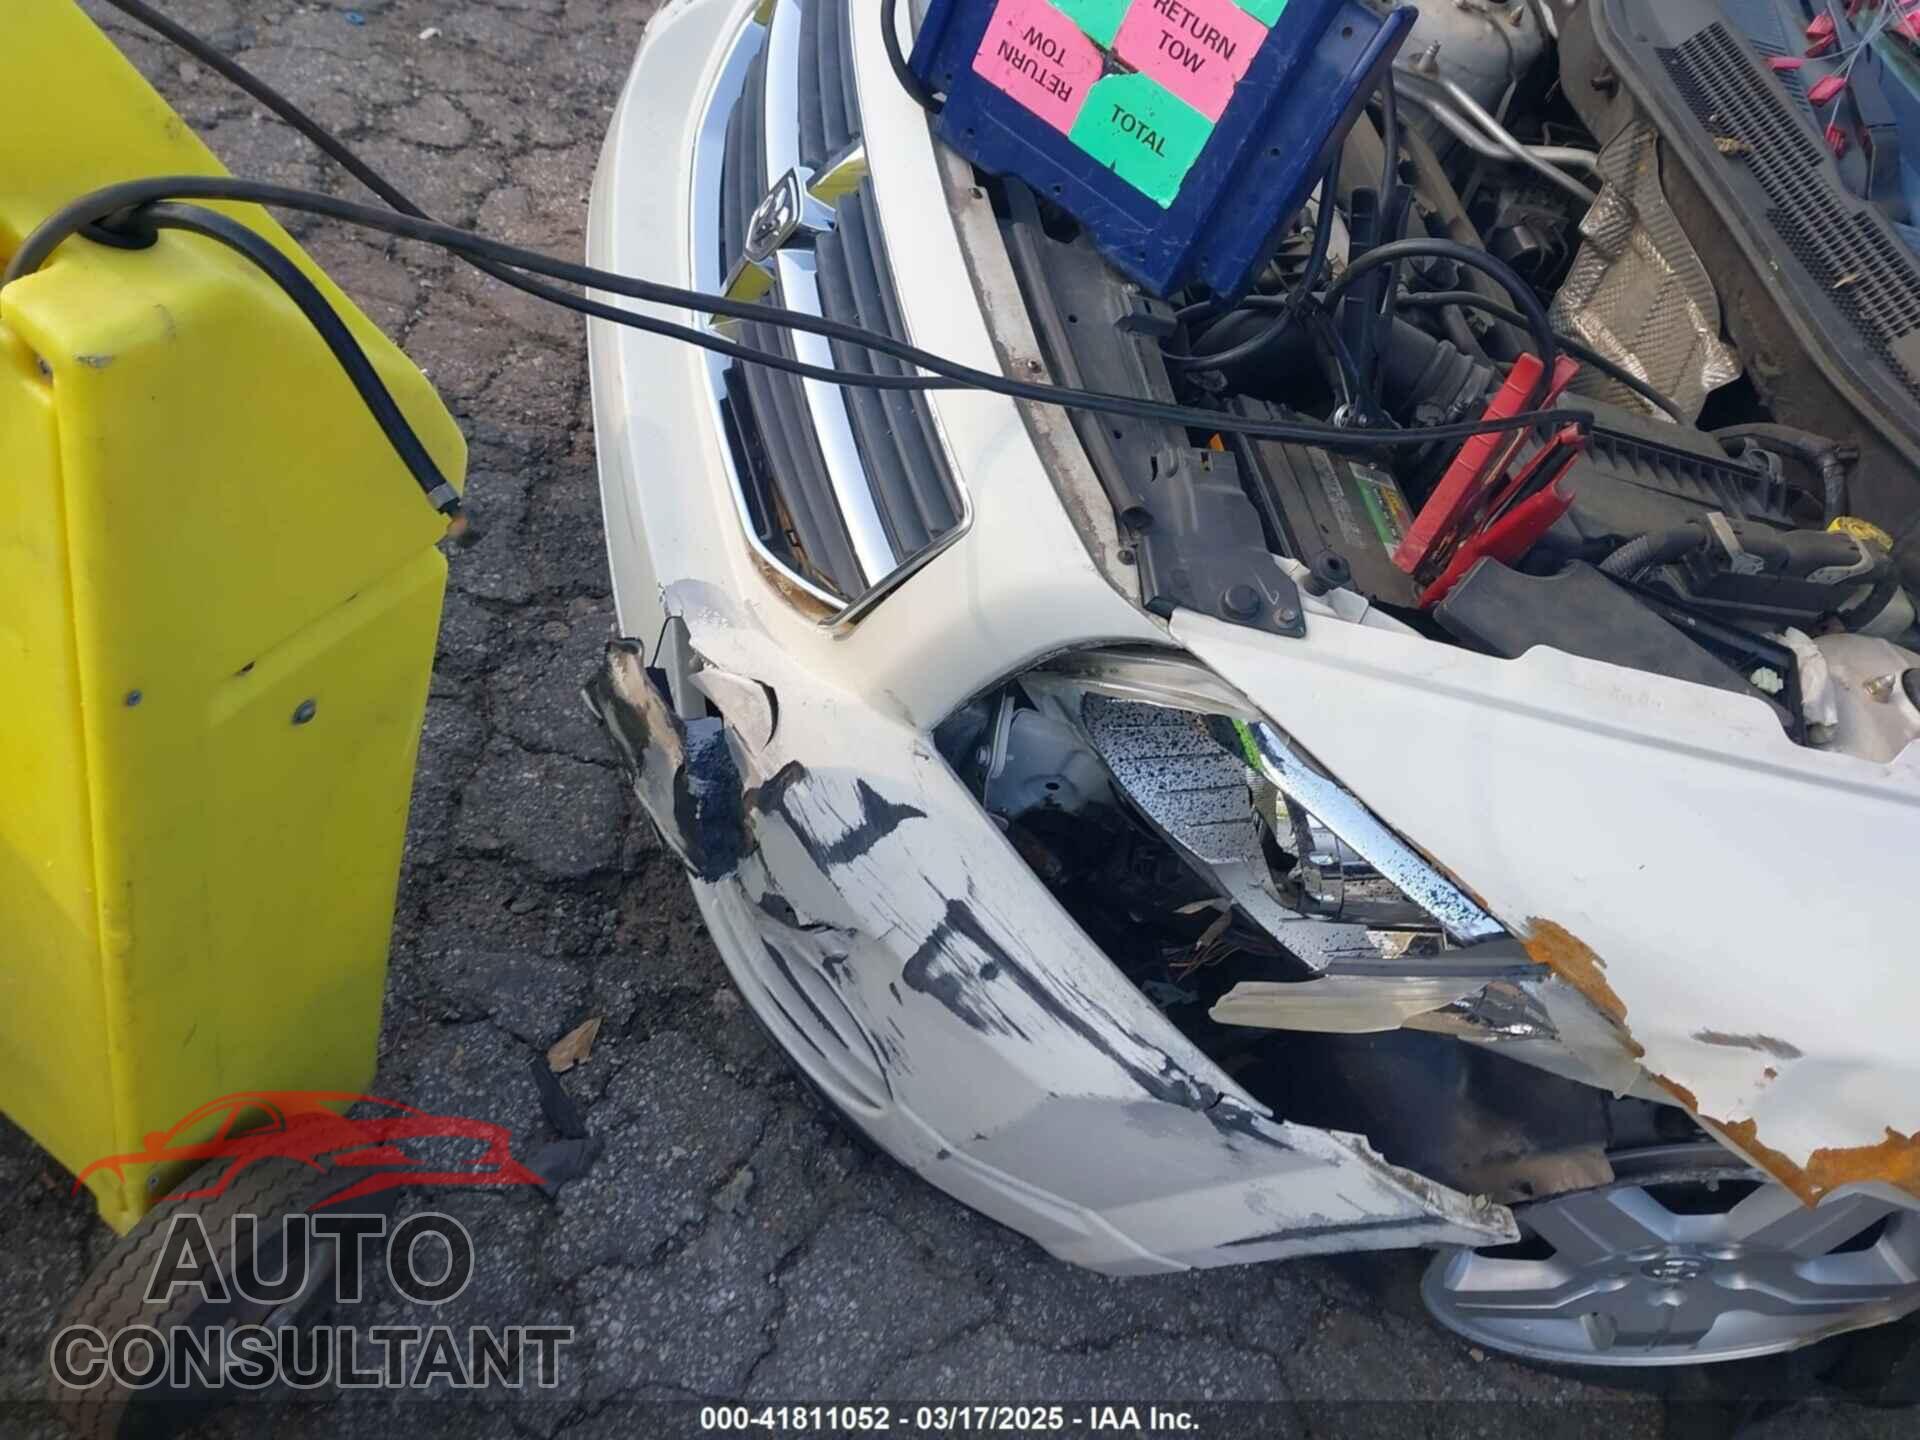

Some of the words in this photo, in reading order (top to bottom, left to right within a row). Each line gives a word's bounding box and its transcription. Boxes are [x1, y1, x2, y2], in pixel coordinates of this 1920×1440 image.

[1023, 26, 1067, 67] TOW
[1152, 0, 1237, 61] RETURN
[1158, 32, 1206, 75] TOW
[997, 39, 1073, 102] RETURN
[1111, 104, 1167, 158] TOTAL
